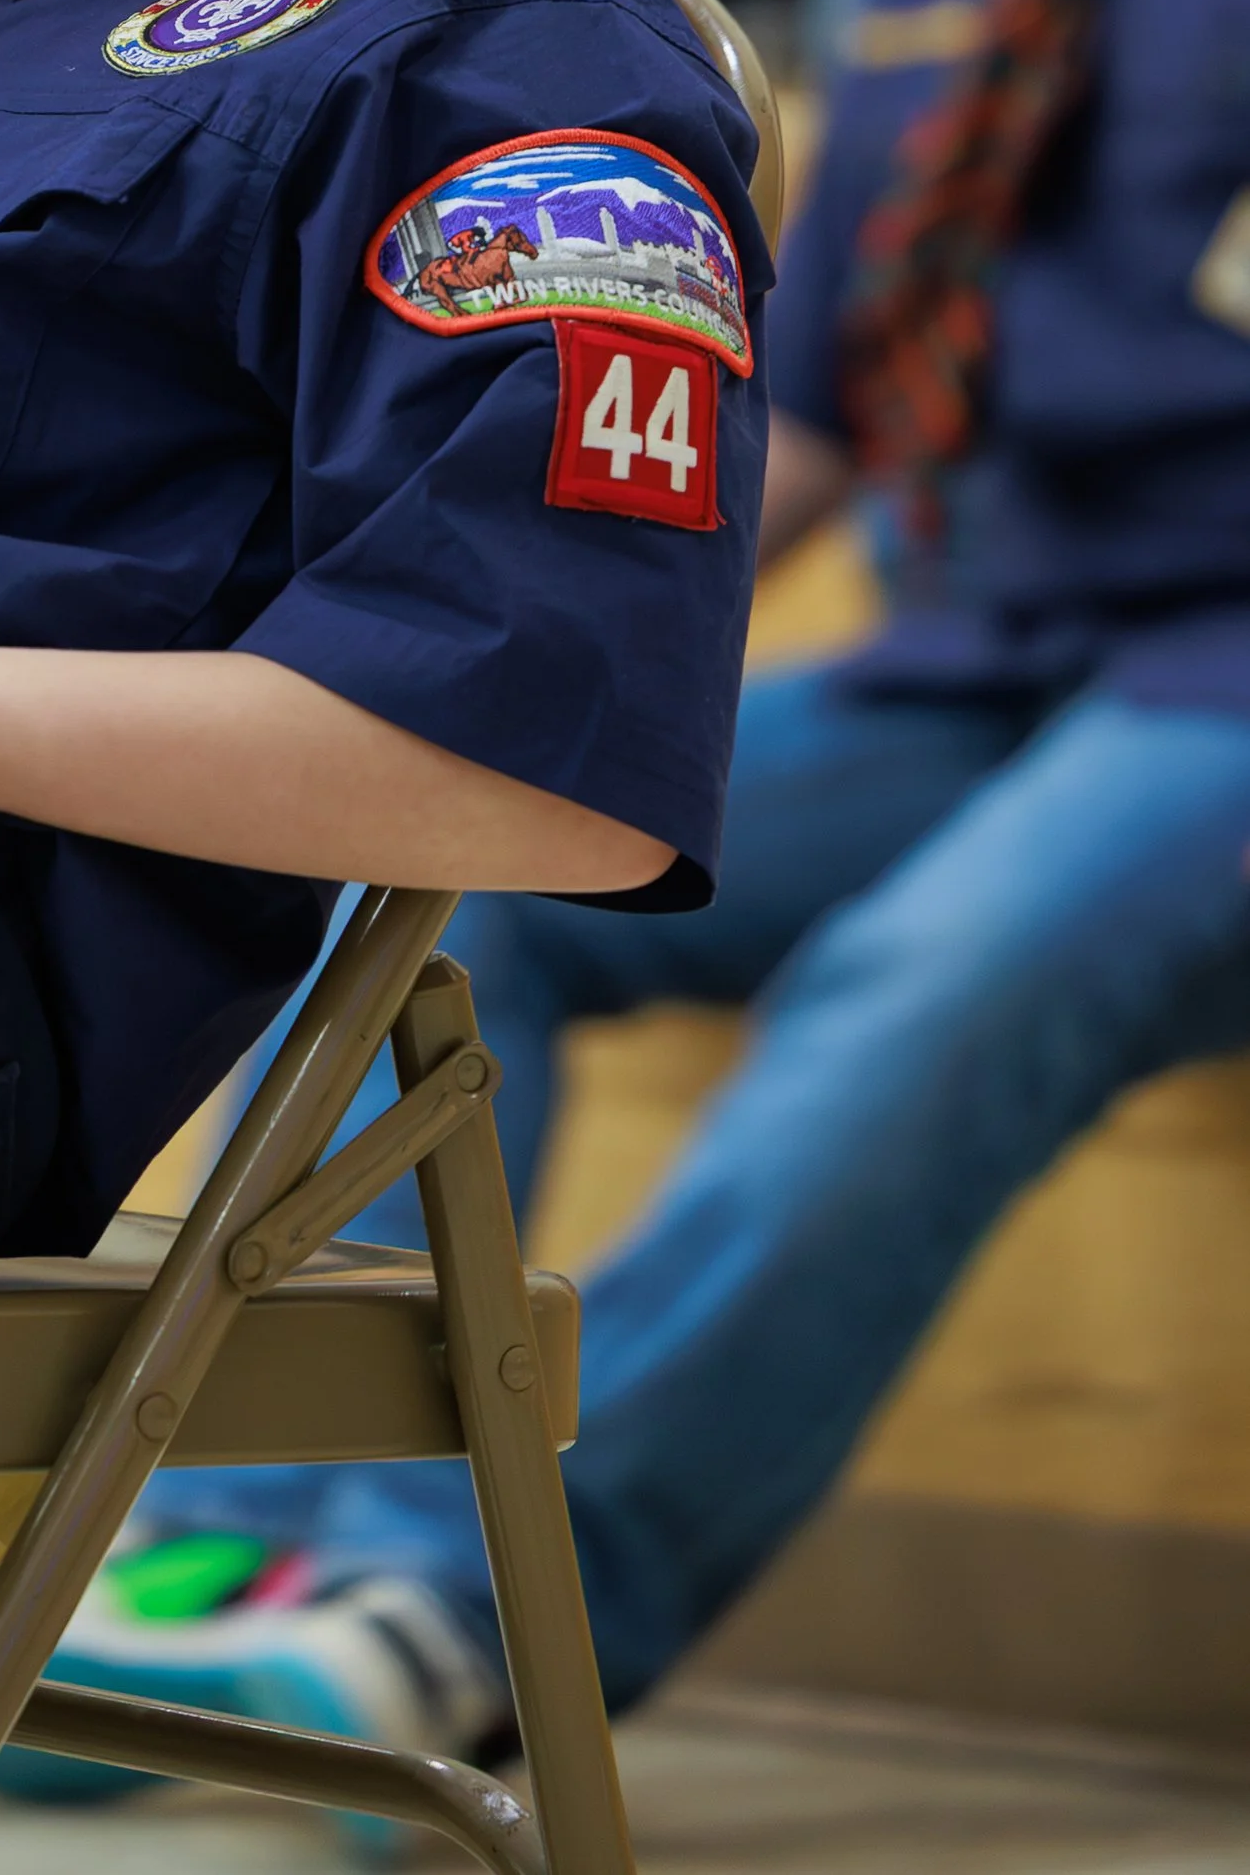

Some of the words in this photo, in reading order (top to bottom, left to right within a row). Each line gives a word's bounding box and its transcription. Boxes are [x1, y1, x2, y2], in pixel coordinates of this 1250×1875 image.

[121, 46, 174, 68] SINCE
[170, 46, 221, 67] 1910
[467, 278, 548, 310] TWIN
[553, 276, 647, 307] RIVERS
[581, 354, 697, 493] 44
